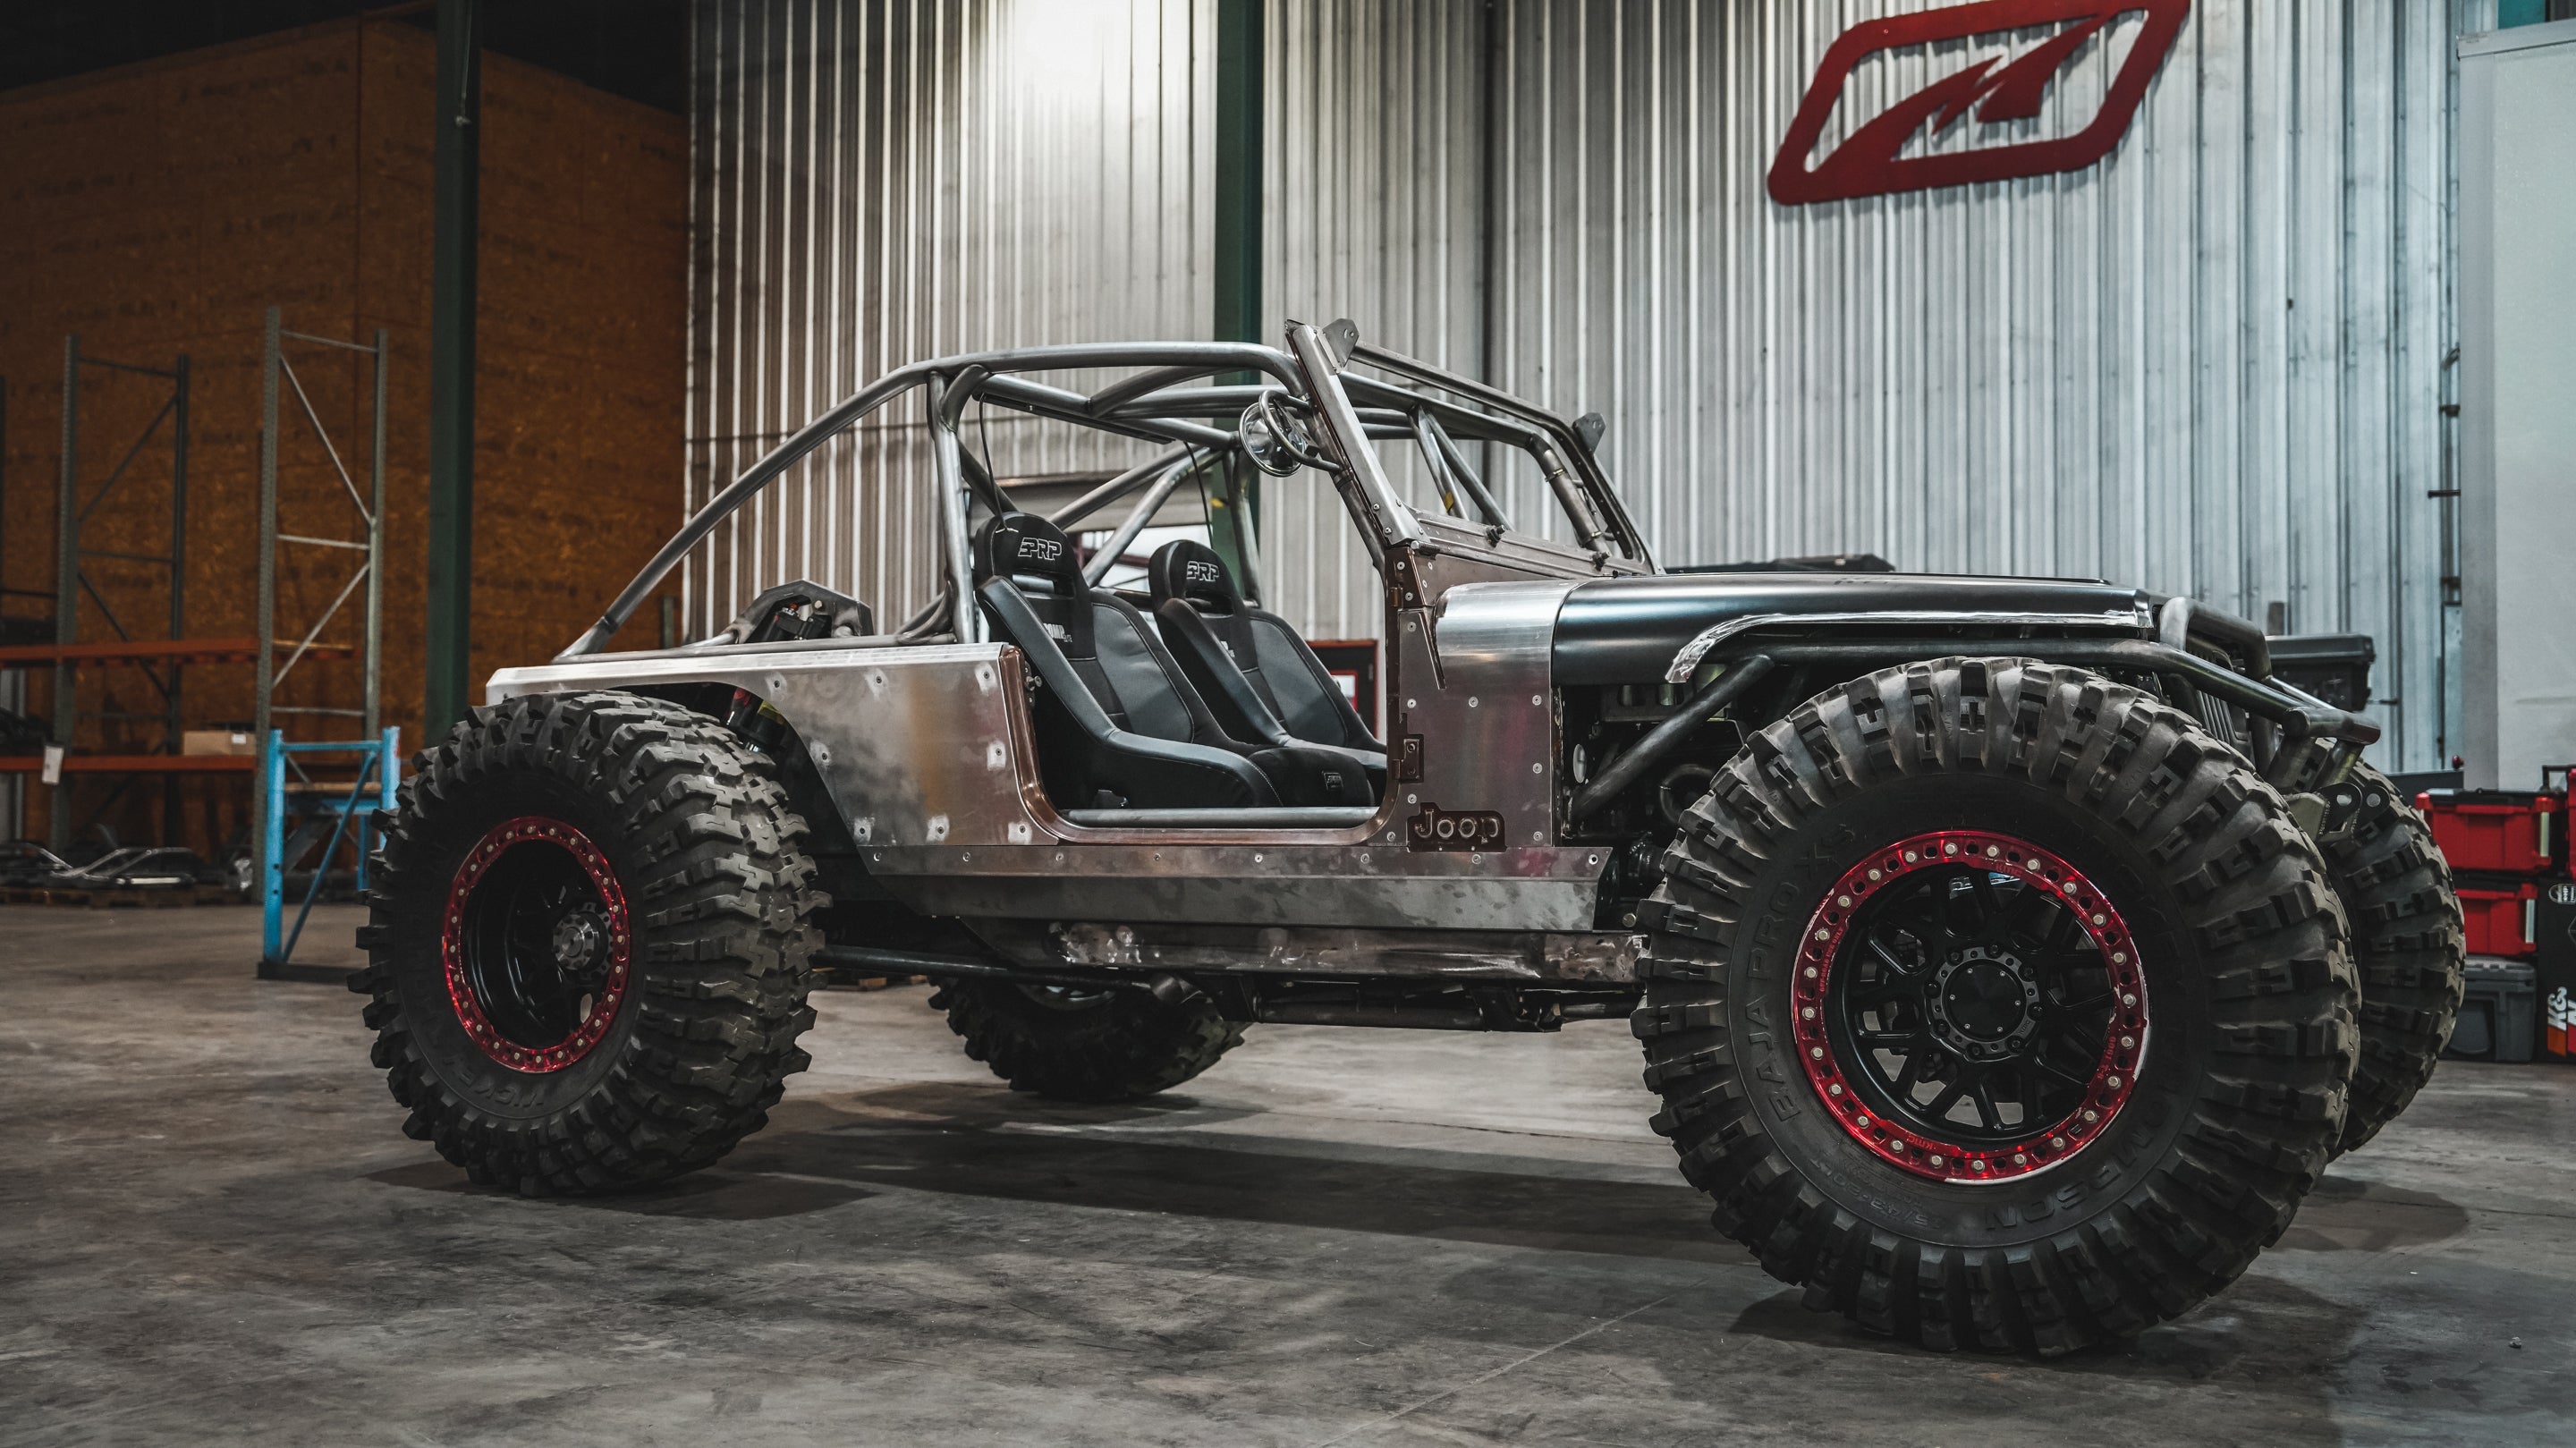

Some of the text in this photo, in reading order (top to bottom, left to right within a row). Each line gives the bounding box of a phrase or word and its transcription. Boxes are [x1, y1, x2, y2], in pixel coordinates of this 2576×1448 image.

[1018, 538, 1063, 561] PRP
[1186, 560, 1219, 581] PRP
[1746, 881, 1800, 980] PRO
[1746, 995, 1800, 1123] BAJA
